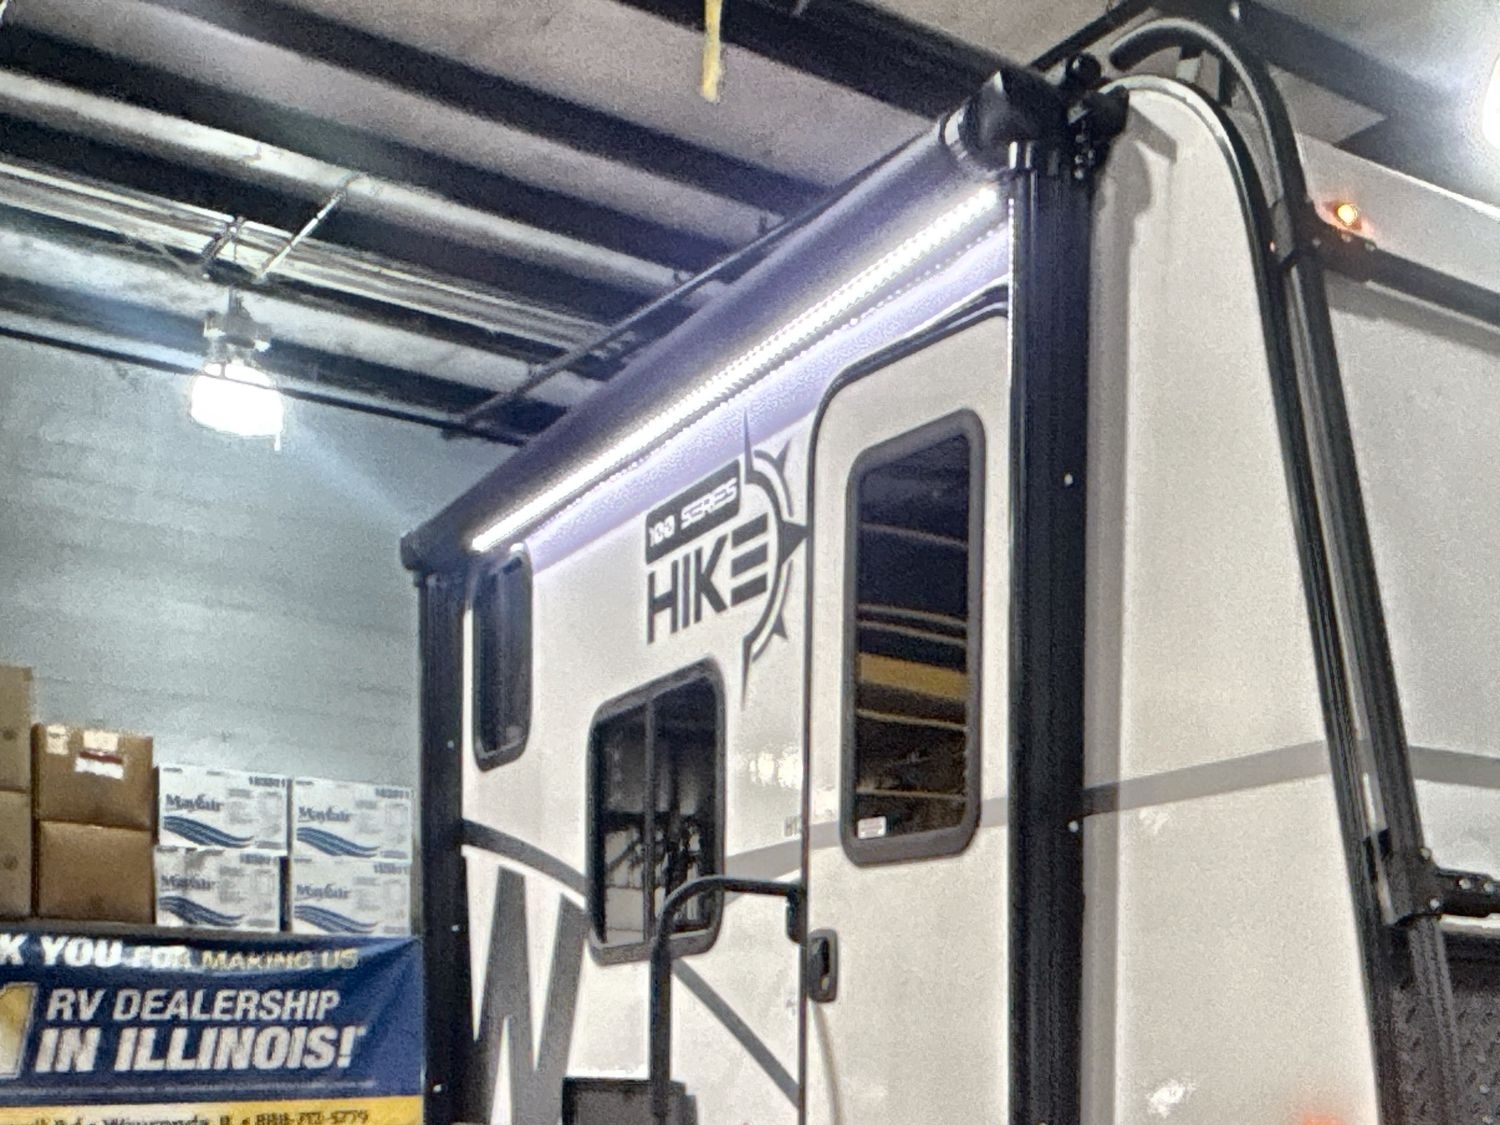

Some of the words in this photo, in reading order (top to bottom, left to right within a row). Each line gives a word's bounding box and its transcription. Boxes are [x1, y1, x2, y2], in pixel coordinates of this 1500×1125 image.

[681, 477, 738, 530] SERIES
[648, 512, 768, 645] HIKE
[165, 794, 223, 813] Mayfair
[298, 807, 351, 823] Mayfair
[40, 936, 123, 968] YOU
[202, 949, 314, 971] MAKING
[320, 948, 359, 970] US
[47, 988, 106, 1022] RV
[112, 988, 341, 1022] DEALERSHIP
[35, 1026, 101, 1073] IN
[114, 1025, 357, 1072] ILLINOIS!
